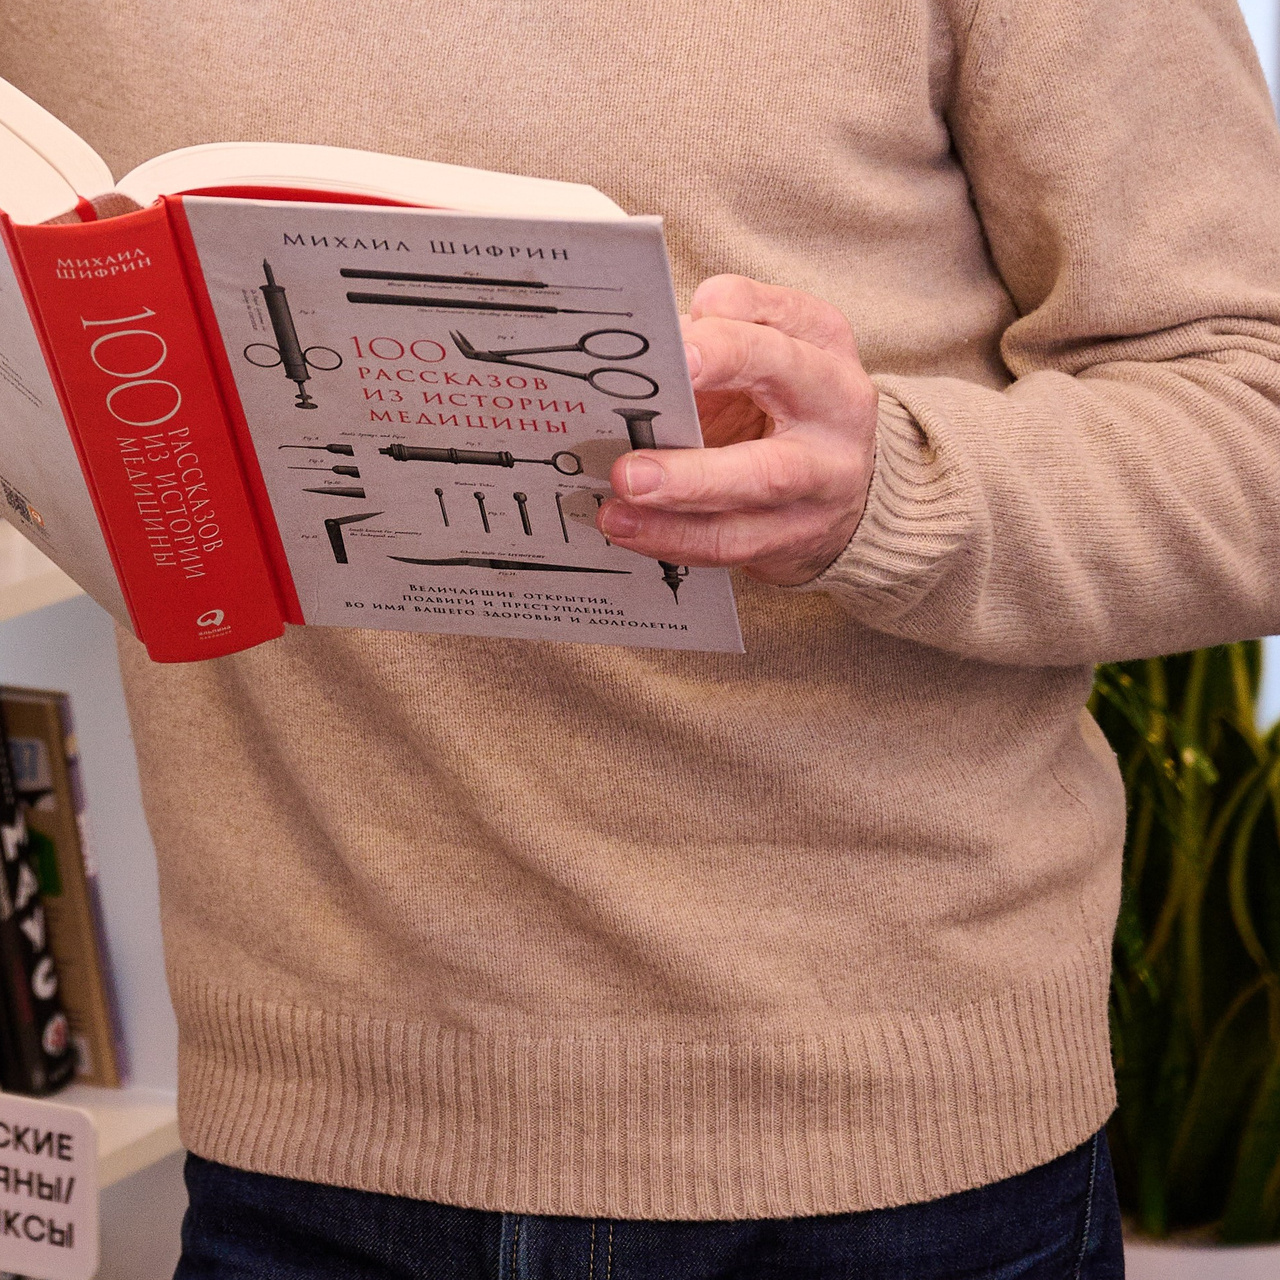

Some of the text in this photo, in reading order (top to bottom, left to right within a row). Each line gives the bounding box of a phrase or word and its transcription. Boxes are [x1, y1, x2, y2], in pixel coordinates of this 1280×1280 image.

[57, 248, 145, 269] МИХАИЛ
[283, 231, 569, 262] МИХАИЛ ШИФРИН
[57, 257, 152, 280] ШИФРИН
[350, 335, 447, 363] 100
[81, 305, 182, 427] 100
[358, 366, 549, 391] РАССКАЗОВ
[363, 387, 587, 415] ИЗ ИСТОРИИ
[369, 408, 568, 434] МЕДИЦИНЫ
[116, 437, 177, 568] МЕДИЦИНЫ
[168, 427, 224, 553] РАССКАЗОВ
[143, 433, 206, 580] ИЗ ИСТОРИИ
[345, 600, 689, 632] ВО ИМЯ ВАШЕГО ЗДОРОВЬЯ И ДОЛГОЛЕТИЯ
[402, 594, 625, 616] ПОДВИГИ И ПРЕСТУПЛЕНИЯ
